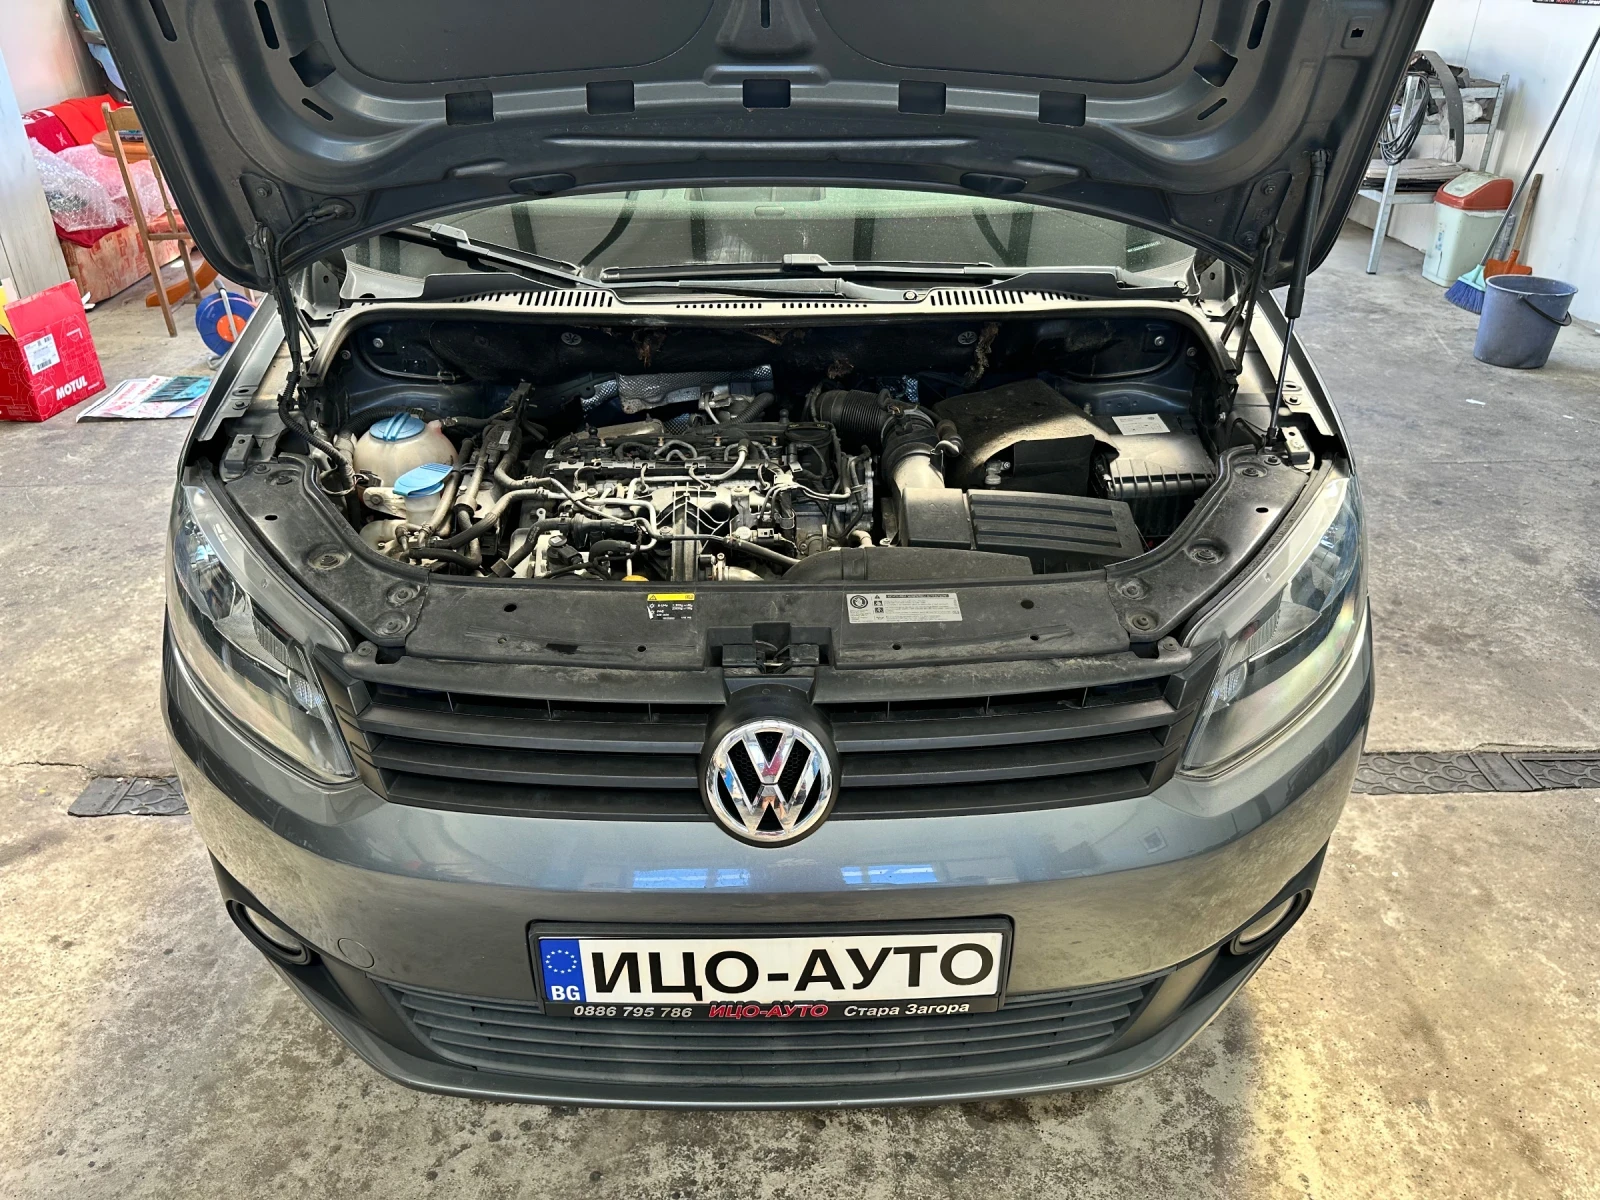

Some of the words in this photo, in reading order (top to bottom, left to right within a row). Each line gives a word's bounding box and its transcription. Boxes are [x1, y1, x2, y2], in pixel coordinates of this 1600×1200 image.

[56, 375, 88, 401] MOTUL
[591, 943, 994, 1001] ИЦО-АУТО
[551, 986, 581, 1001] BG
[573, 1005, 617, 1017] 0886
[622, 1006, 655, 1018] 795
[660, 1007, 693, 1018] 786
[708, 1003, 829, 1019] ИЦО-АУТО
[843, 1005, 901, 1018] Стара
[905, 1003, 970, 1016] Загора
